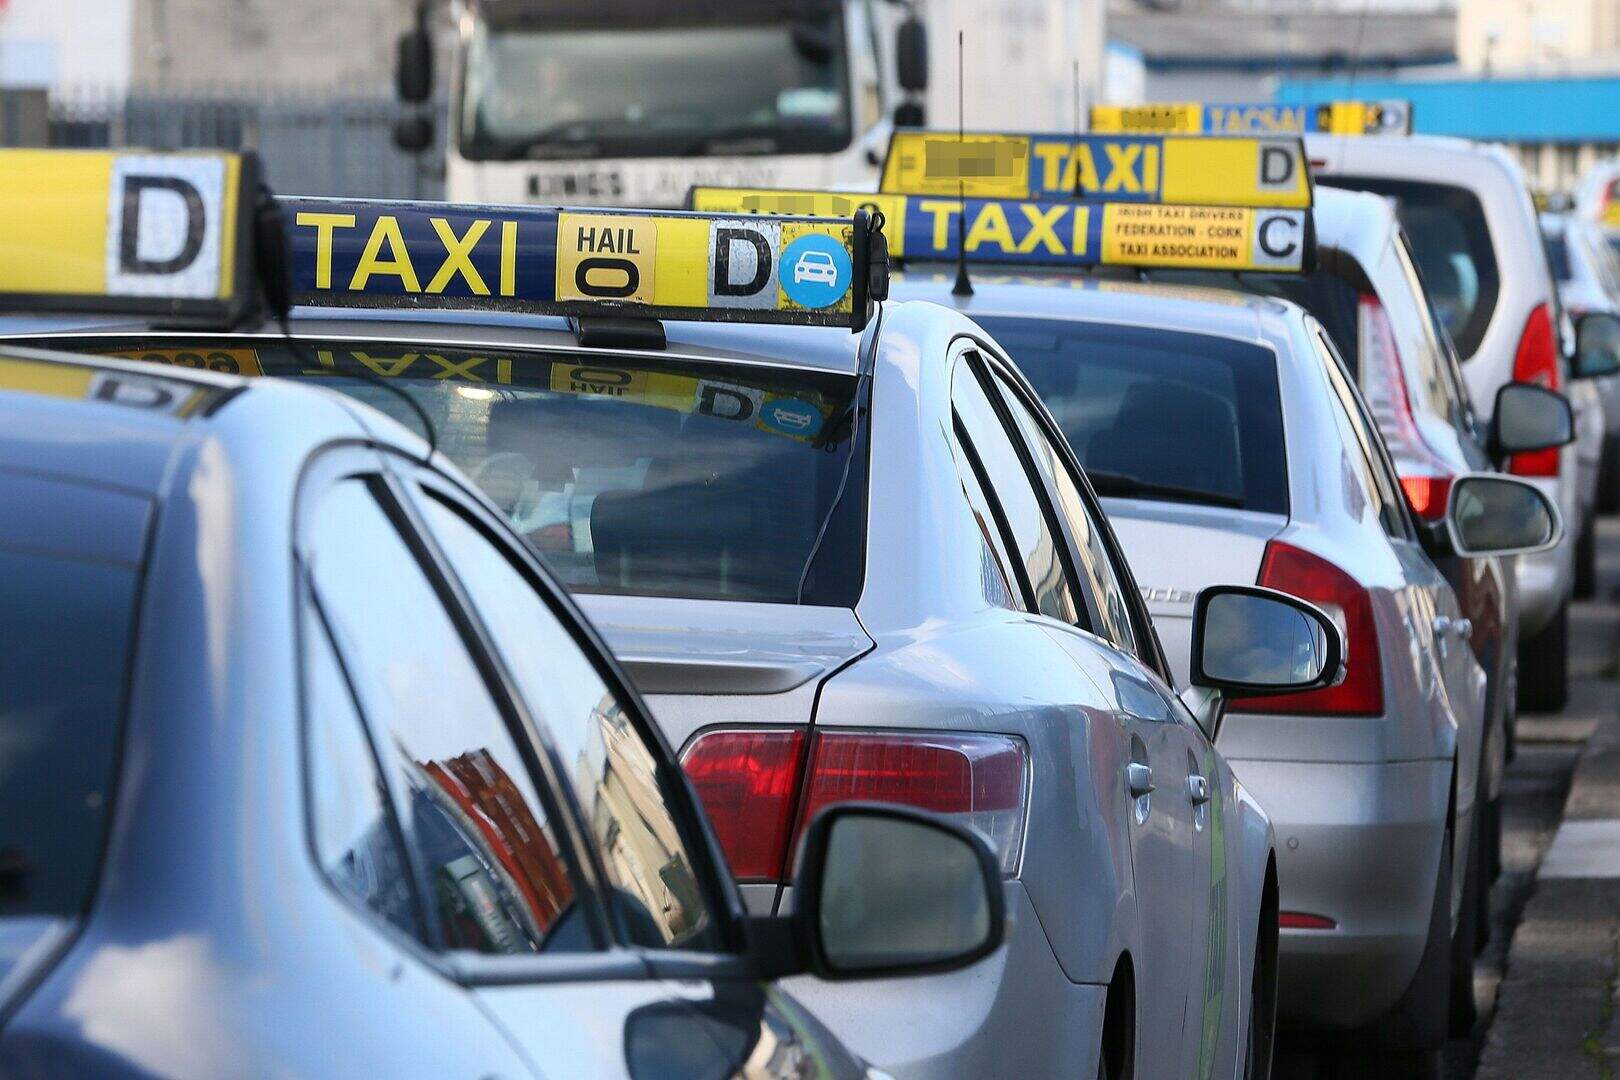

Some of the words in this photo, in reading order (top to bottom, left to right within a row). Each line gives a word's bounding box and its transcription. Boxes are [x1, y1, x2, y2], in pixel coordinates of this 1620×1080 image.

[1033, 141, 1159, 194] TAXI
[1260, 147, 1293, 185] D
[118, 173, 206, 276] D
[919, 199, 1090, 256] TAXI
[1258, 215, 1298, 258] C
[1115, 222, 1196, 237] FEDERATION
[1207, 225, 1244, 239] CORK
[1157, 207, 1185, 219] TAXI
[1189, 208, 1245, 220] DRIVERS
[296, 211, 518, 297] TAXI
[713, 228, 773, 296] D
[576, 226, 640, 255] HAIL
[1119, 242, 1148, 256] TAXI
[1152, 244, 1239, 260] ASSOCIATION
